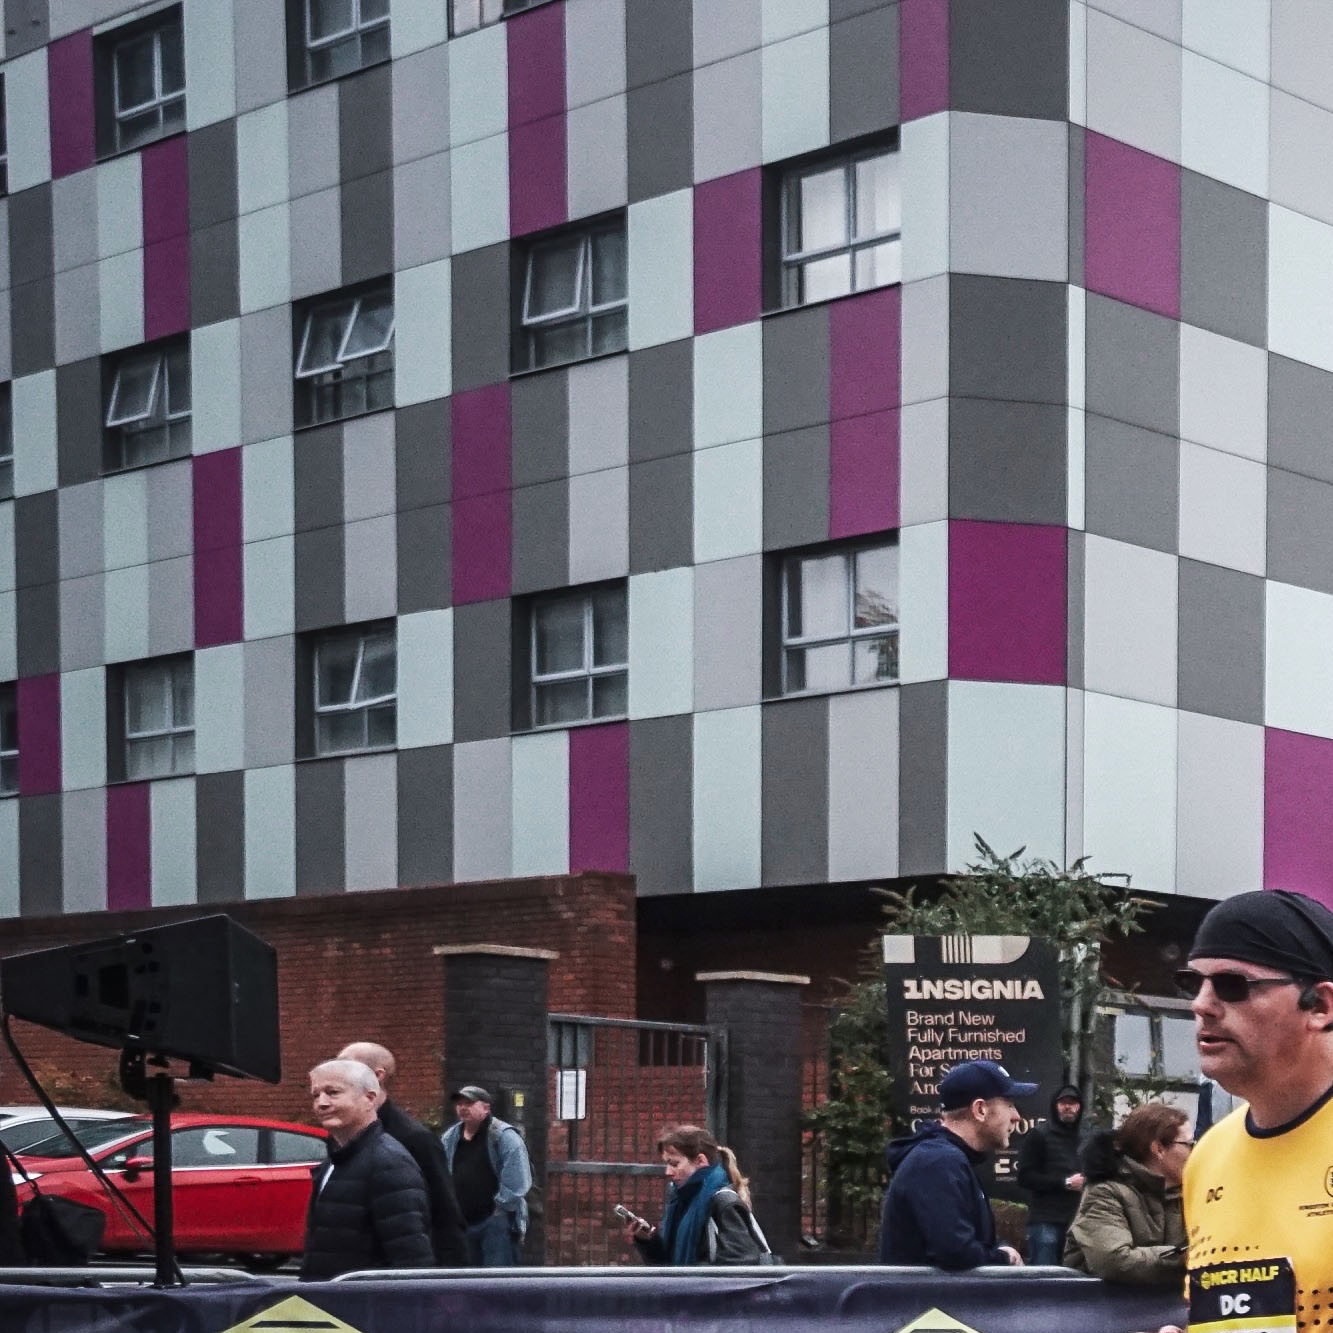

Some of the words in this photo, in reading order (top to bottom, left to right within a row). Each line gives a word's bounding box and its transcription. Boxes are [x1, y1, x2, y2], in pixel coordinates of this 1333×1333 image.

[906, 1010, 954, 1026] Brand
[959, 1010, 995, 1026] New
[908, 1029, 944, 1046] Fully
[949, 1028, 1026, 1043] Furnished
[908, 1046, 1002, 1063] Apartments
[909, 1063, 936, 1078] For
[1240, 1266, 1279, 1283] HALF
[1220, 1294, 1251, 1315] DC
